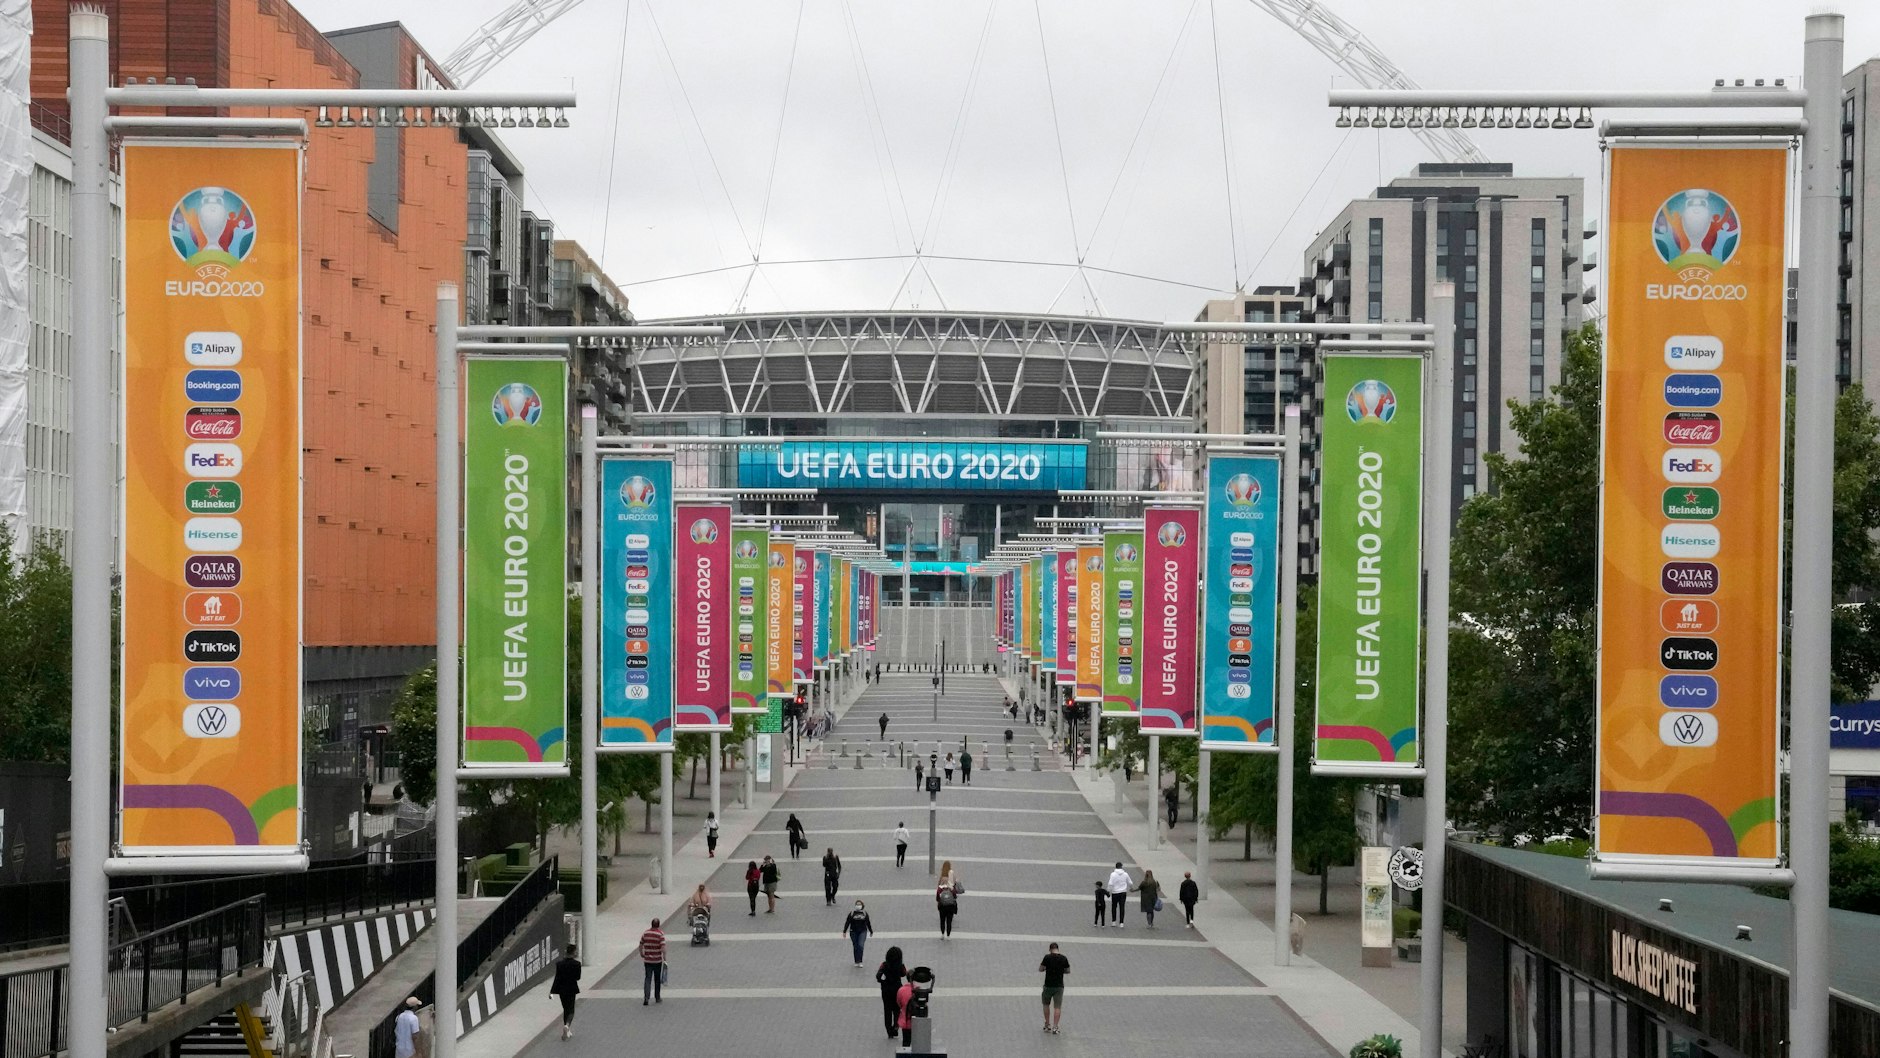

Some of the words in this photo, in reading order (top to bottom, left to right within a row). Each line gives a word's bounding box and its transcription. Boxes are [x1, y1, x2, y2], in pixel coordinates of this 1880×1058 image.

[197, 264, 230, 279] UEFA
[1678, 268, 1711, 282] UEFA
[165, 280, 264, 297] EURO2020
[1646, 284, 1748, 300] EURO2020
[204, 344, 235, 354] Alipay
[1684, 348, 1716, 358] Alipay
[188, 381, 240, 390] Booking.com
[1666, 386, 1720, 395] Booking.com
[192, 454, 235, 467] FedEx
[776, 452, 862, 478] UEFA
[866, 452, 954, 480] EURO
[960, 454, 1040, 480] 2020
[1670, 458, 1714, 472] FedEx
[504, 454, 528, 530] 2020
[1357, 451, 1383, 528] 2020
[191, 500, 236, 508] Heineken
[1668, 506, 1714, 514] Heineken
[188, 530, 238, 538] Hisense
[1665, 536, 1716, 546] Hisense
[190, 562, 235, 575] QATAR
[504, 536, 528, 617] EURO
[697, 558, 711, 599] 2020
[1357, 532, 1382, 616] EURO
[1667, 568, 1712, 582] QATAR
[1164, 560, 1178, 602] 2020
[771, 578, 780, 606] 2020
[1091, 582, 1100, 612] 2020
[697, 602, 711, 642] EURO
[770, 608, 780, 640] EURO
[1091, 612, 1100, 643] EURO
[1163, 605, 1178, 650] EURO
[200, 642, 236, 652] TikTok
[770, 642, 779, 670] UEFA
[1677, 650, 1714, 661] TikTok
[504, 622, 528, 702] UEFA
[696, 648, 710, 692] UEFA
[1090, 646, 1100, 675] UEFA
[1356, 621, 1380, 700] UEFA
[195, 677, 230, 688] vivo
[1162, 652, 1177, 696] UEFA
[1670, 685, 1708, 696] vivo
[1829, 715, 1880, 735] Currys
[1612, 929, 1637, 986] BLACK
[1637, 940, 1662, 998] SHEEP
[1663, 952, 1696, 1015] COFFEE
